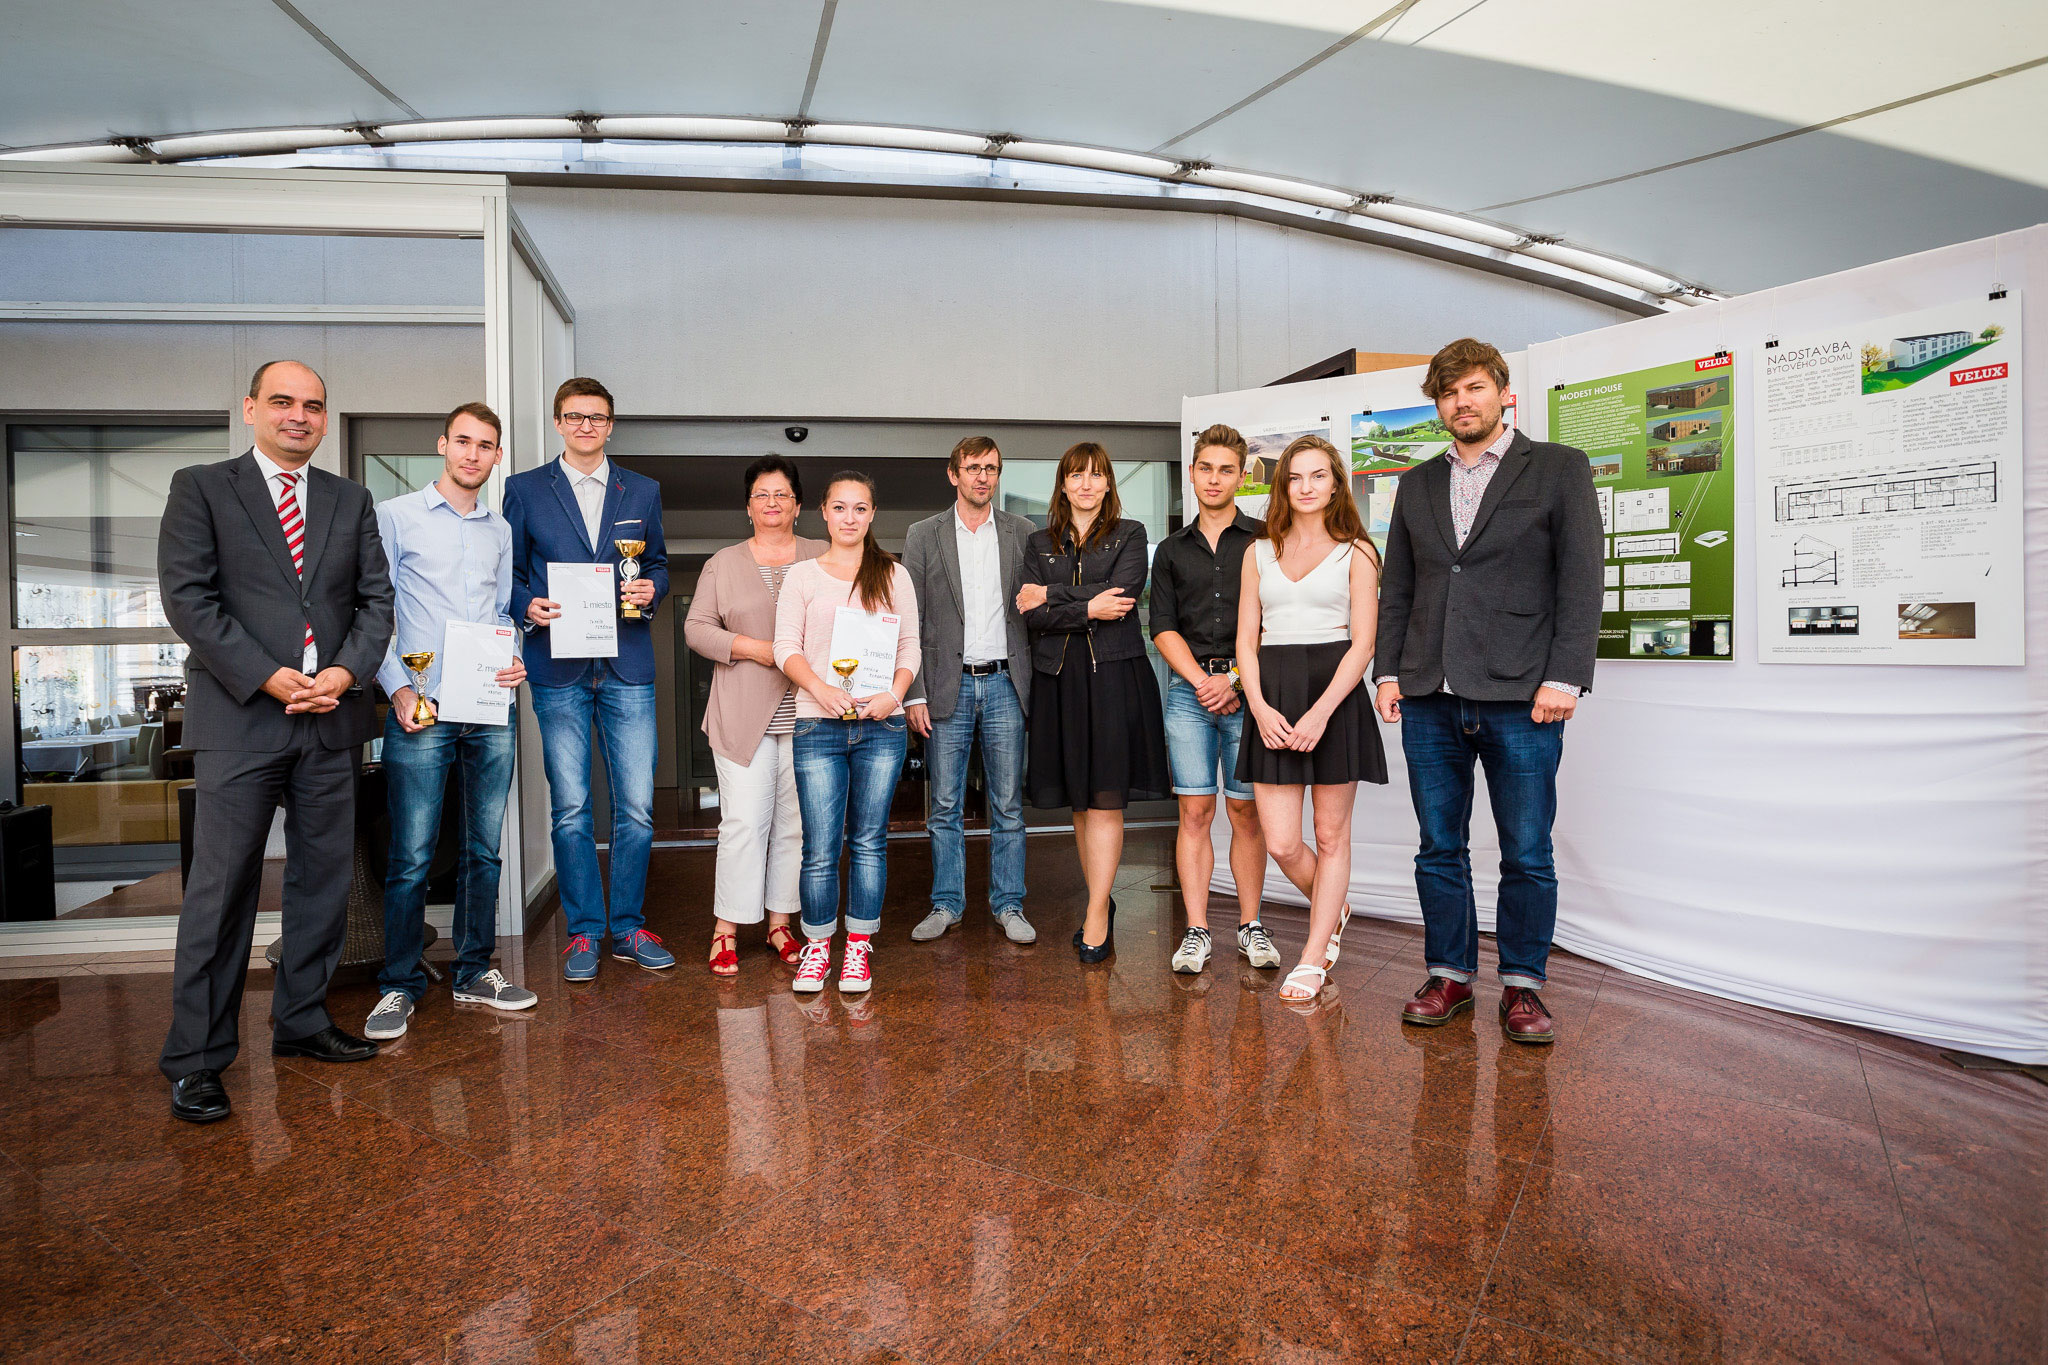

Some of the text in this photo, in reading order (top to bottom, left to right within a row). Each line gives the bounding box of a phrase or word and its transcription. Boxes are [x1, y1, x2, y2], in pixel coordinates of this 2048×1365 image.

[1767, 340, 1852, 366] NADSTAVBA
[1697, 356, 1730, 369] VELUX
[1766, 352, 1853, 375] BYTOVÉHO DOMU
[1953, 366, 2004, 383] VELUX
[1559, 383, 1623, 402] MODEST HOUSE
[589, 600, 613, 609] miesto
[870, 651, 893, 660] miesto
[476, 663, 484, 672] 2.
